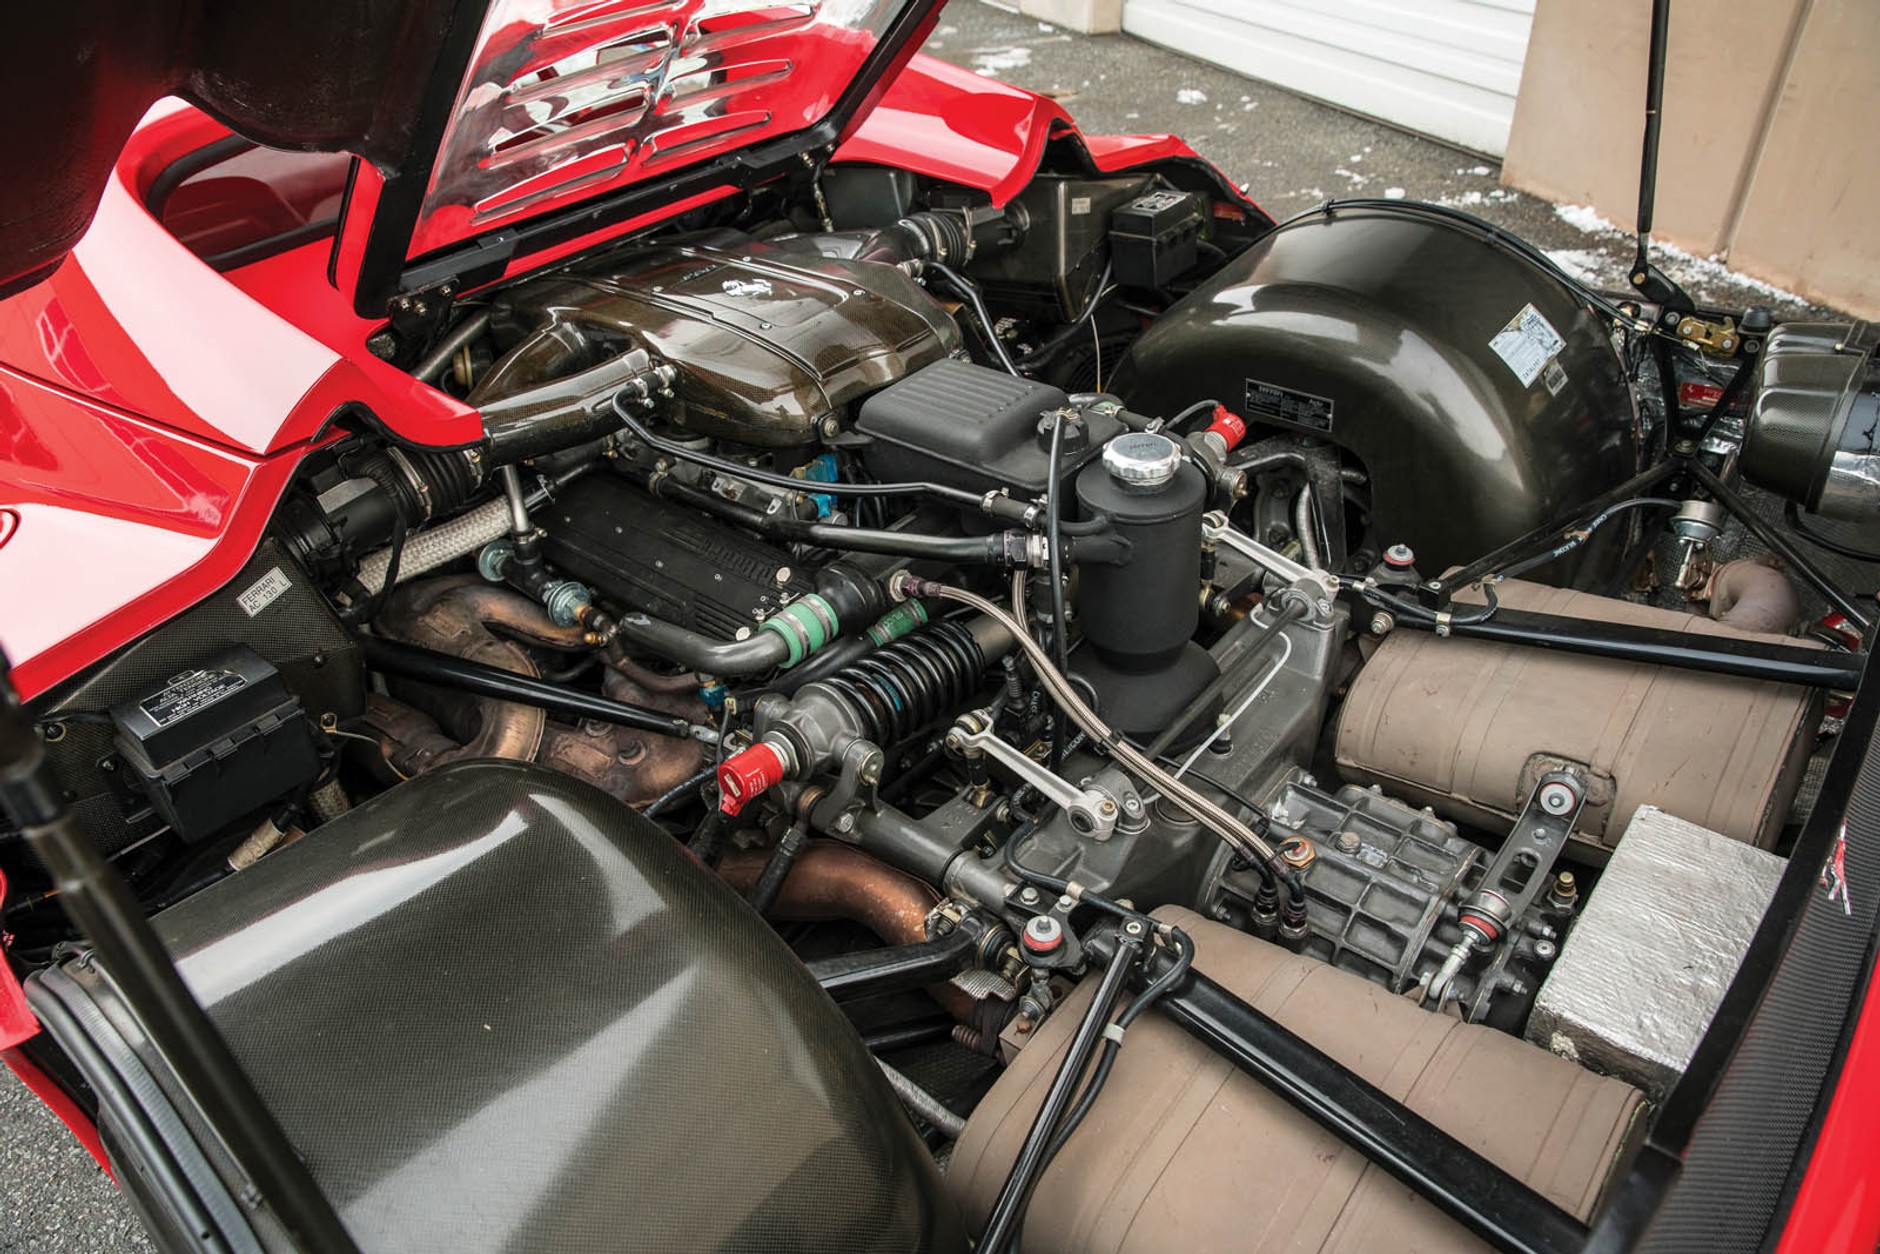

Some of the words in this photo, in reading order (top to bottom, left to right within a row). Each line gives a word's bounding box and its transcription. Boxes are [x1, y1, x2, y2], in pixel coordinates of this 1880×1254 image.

[241, 576, 275, 606] FERRARI
[249, 600, 261, 613] AC
[263, 586, 278, 600] 130
[158, 692, 177, 703] ALTA
[192, 683, 226, 702] VOLTAGE
